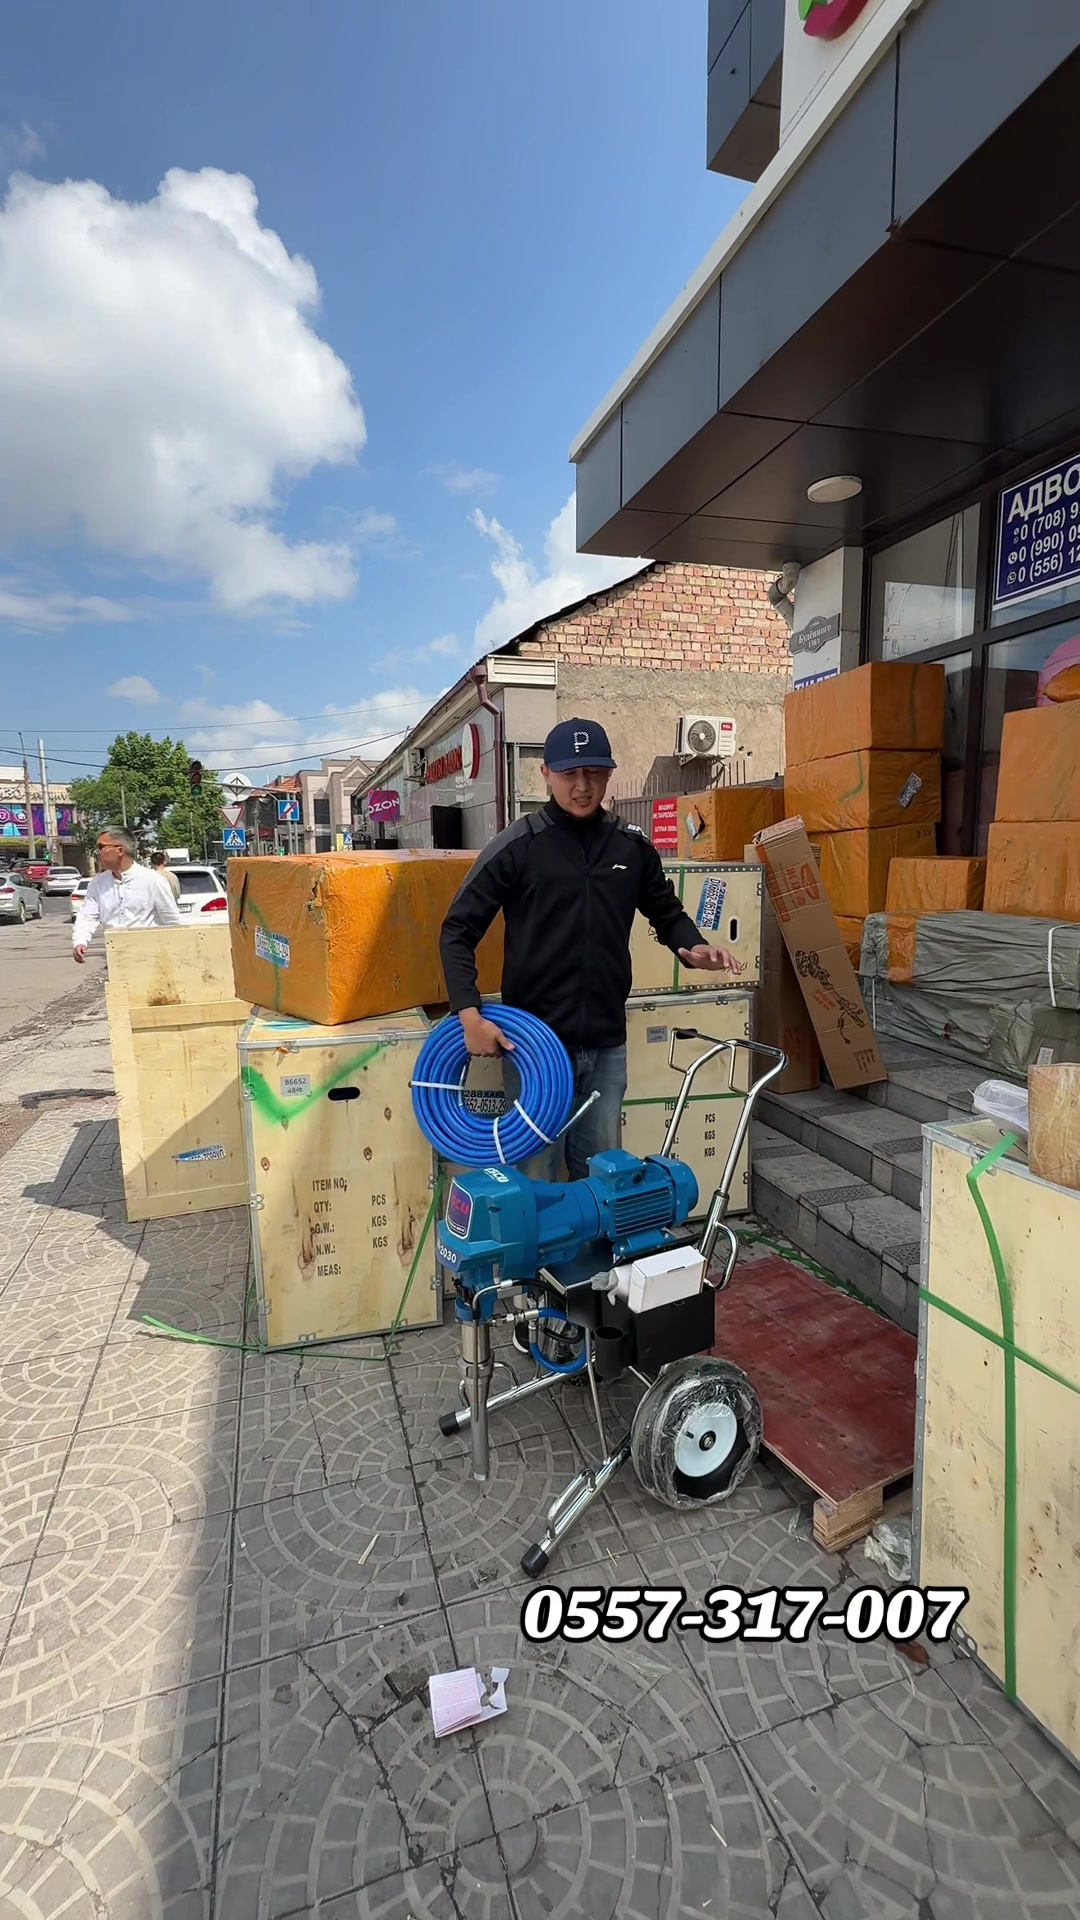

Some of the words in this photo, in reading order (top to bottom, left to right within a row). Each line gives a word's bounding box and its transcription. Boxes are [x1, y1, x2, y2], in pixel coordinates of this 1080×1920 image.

[1032, 507, 1066, 539] (708)
[1070, 502, 1080, 519] 9
[1030, 530, 1064, 562] (990)
[1029, 552, 1063, 582] (556)
[704, 1113, 716, 1123] PCS
[704, 1130, 716, 1140] KGS
[704, 1147, 716, 1157] KGS
[312, 1179, 332, 1192] ITEM
[371, 1194, 386, 1206] PCS
[313, 1201, 332, 1213] QTY:
[371, 1215, 387, 1228] KGS
[372, 1236, 388, 1248] KGS
[316, 1243, 336, 1256] N.W.:
[317, 1264, 342, 1277] MEAS:
